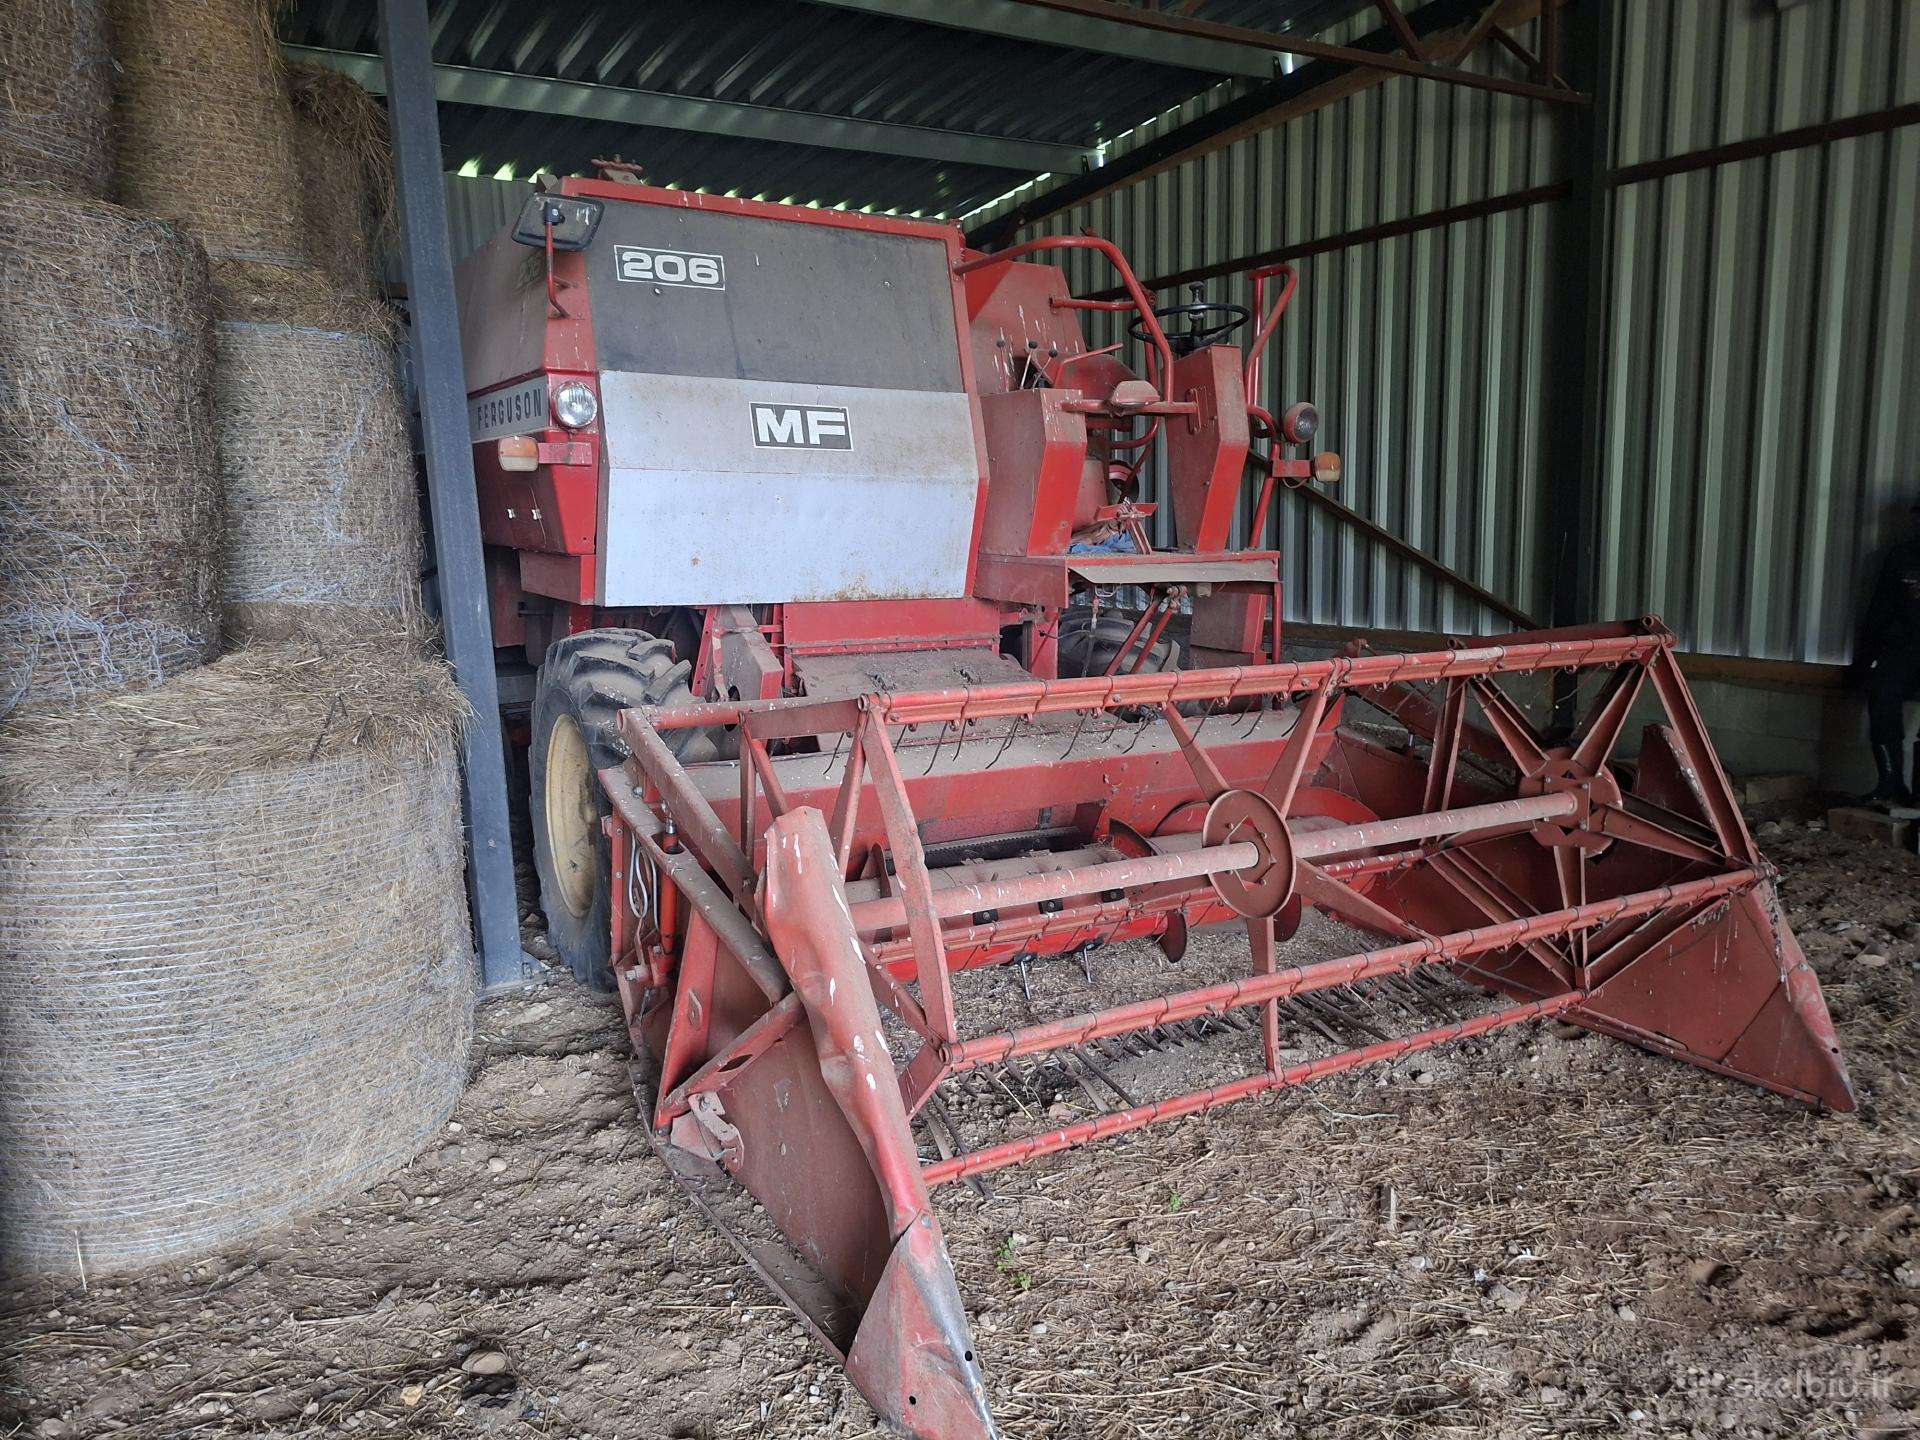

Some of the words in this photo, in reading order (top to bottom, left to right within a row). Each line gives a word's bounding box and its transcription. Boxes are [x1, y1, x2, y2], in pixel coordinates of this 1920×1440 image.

[621, 251, 720, 285] 206
[476, 388, 542, 431] FERGUSON
[755, 407, 846, 445] MF
